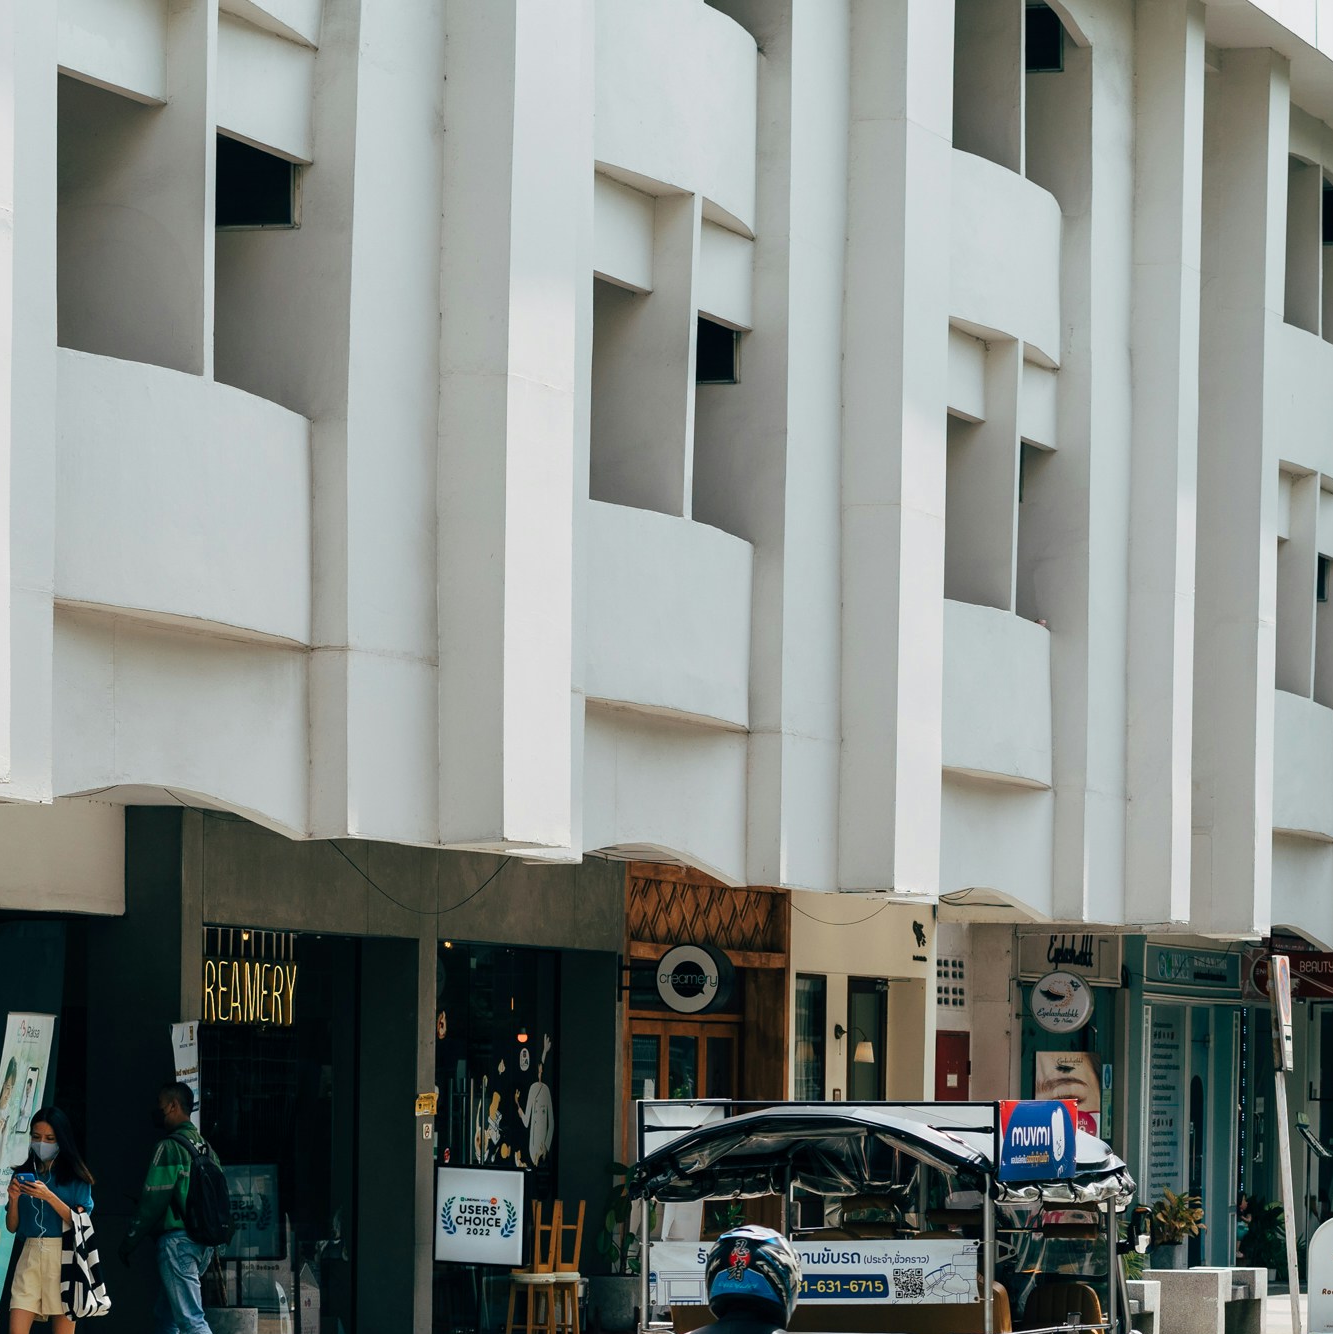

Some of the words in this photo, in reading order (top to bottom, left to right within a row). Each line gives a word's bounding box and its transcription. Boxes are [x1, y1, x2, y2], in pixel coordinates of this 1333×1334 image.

[659, 973, 718, 988] creamery
[204, 960, 297, 1025] REAMERY
[459, 1204, 501, 1216] USERS'
[455, 1215, 502, 1228] CHOICE
[466, 1227, 490, 1236] 2022
